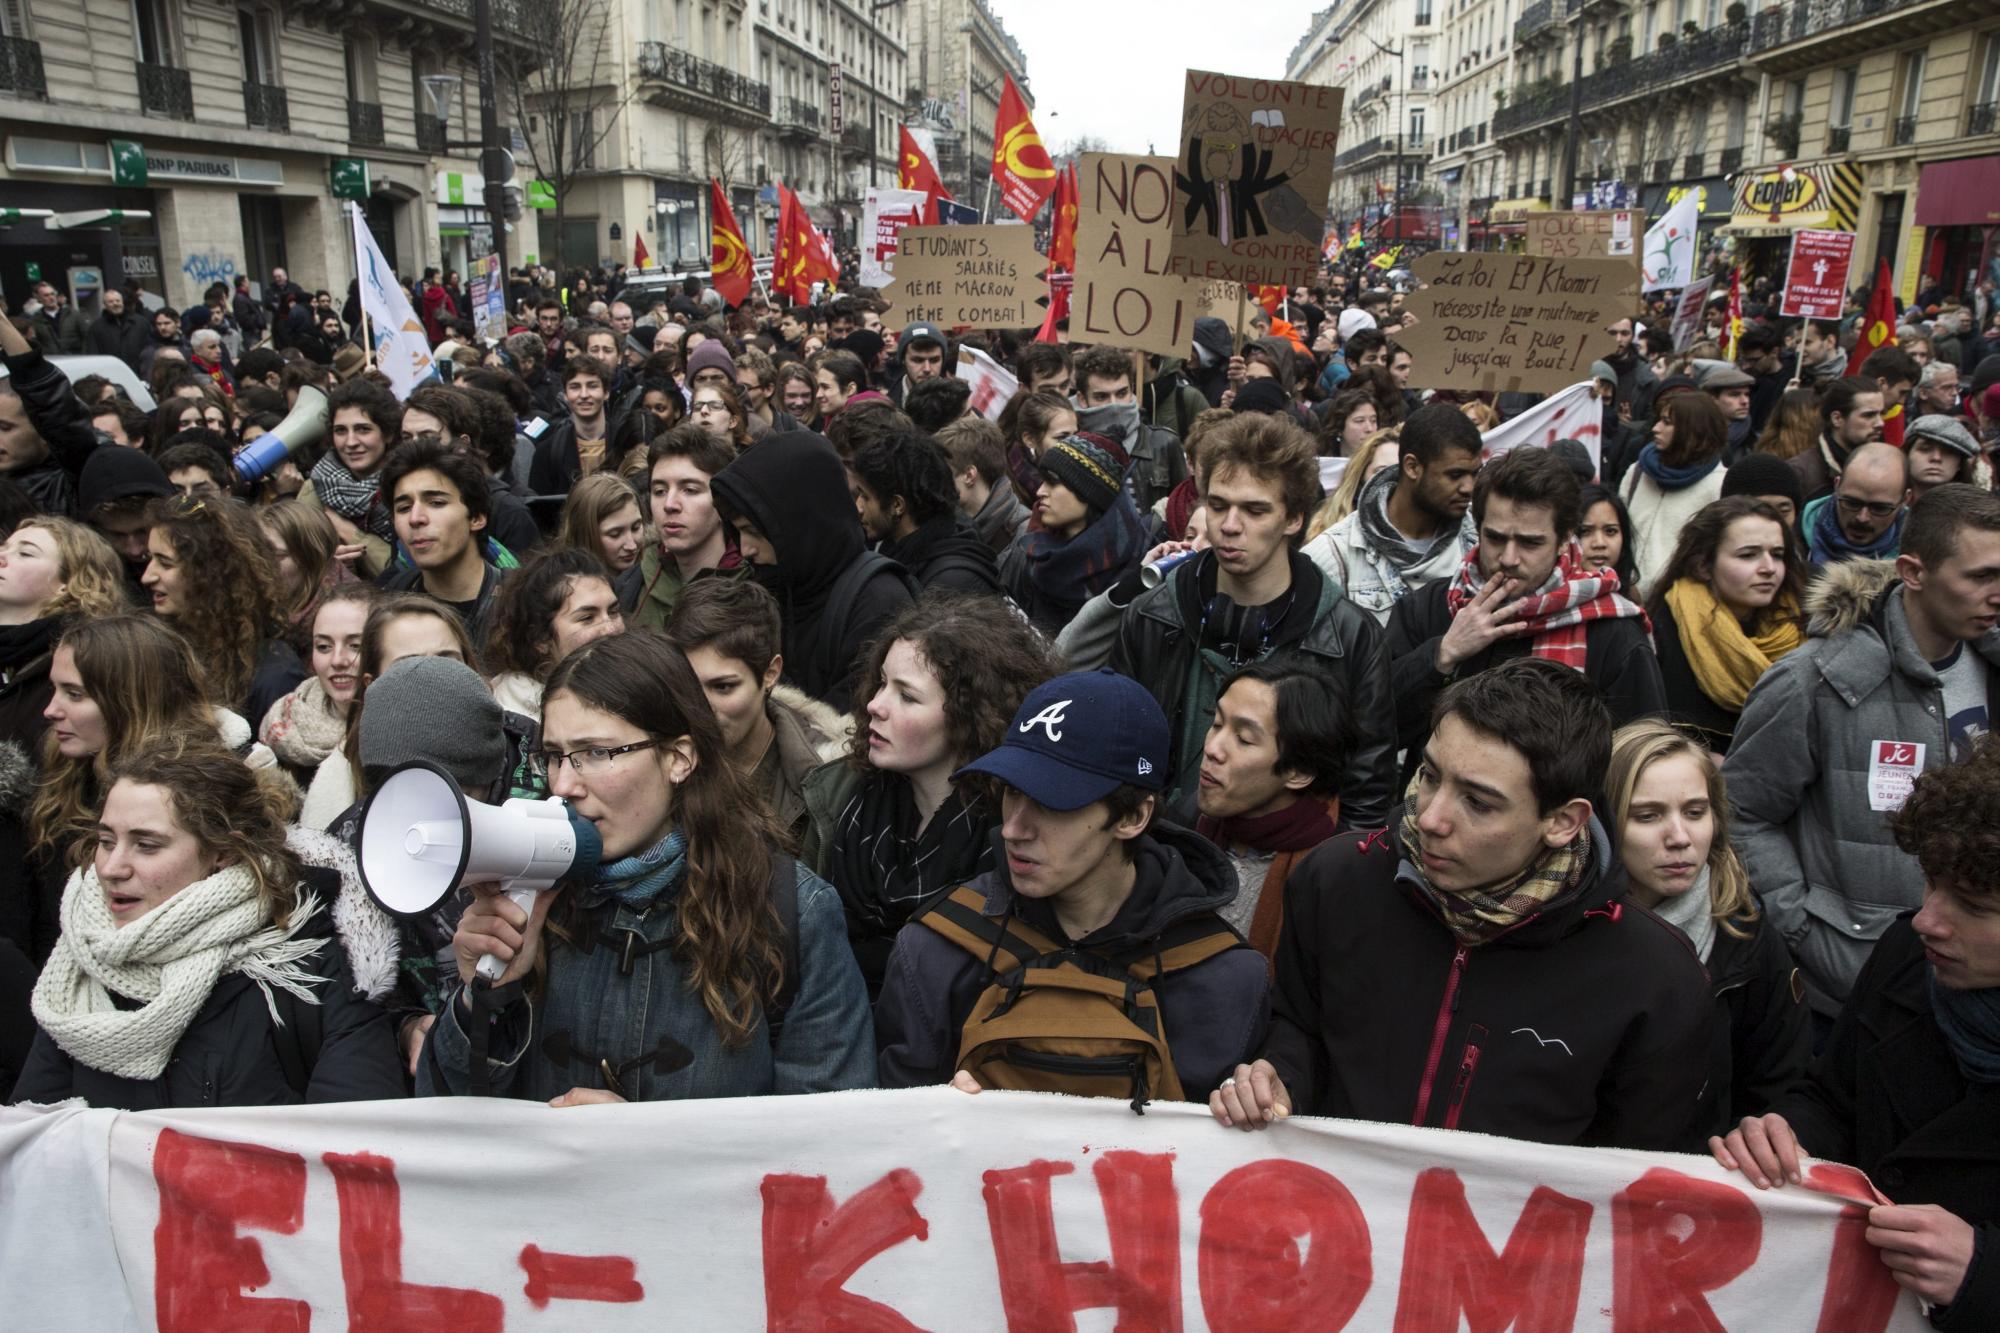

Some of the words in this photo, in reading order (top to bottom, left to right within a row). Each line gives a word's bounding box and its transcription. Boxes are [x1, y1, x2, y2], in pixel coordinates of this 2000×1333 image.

[831, 66, 841, 131] HOTEL
[147, 157, 174, 171] BNP
[178, 159, 231, 176] PARIBAS
[1535, 217, 1612, 236] TOUCHE
[1099, 222, 1126, 267] À
[1232, 241, 1318, 265] CONTRE
[1541, 238, 1580, 257] PAS
[122, 256, 157, 273] CONSEIL
[955, 280, 1014, 297] MACRON
[1536, 260, 1601, 296] Khomri
[1085, 282, 1182, 346] LOI
